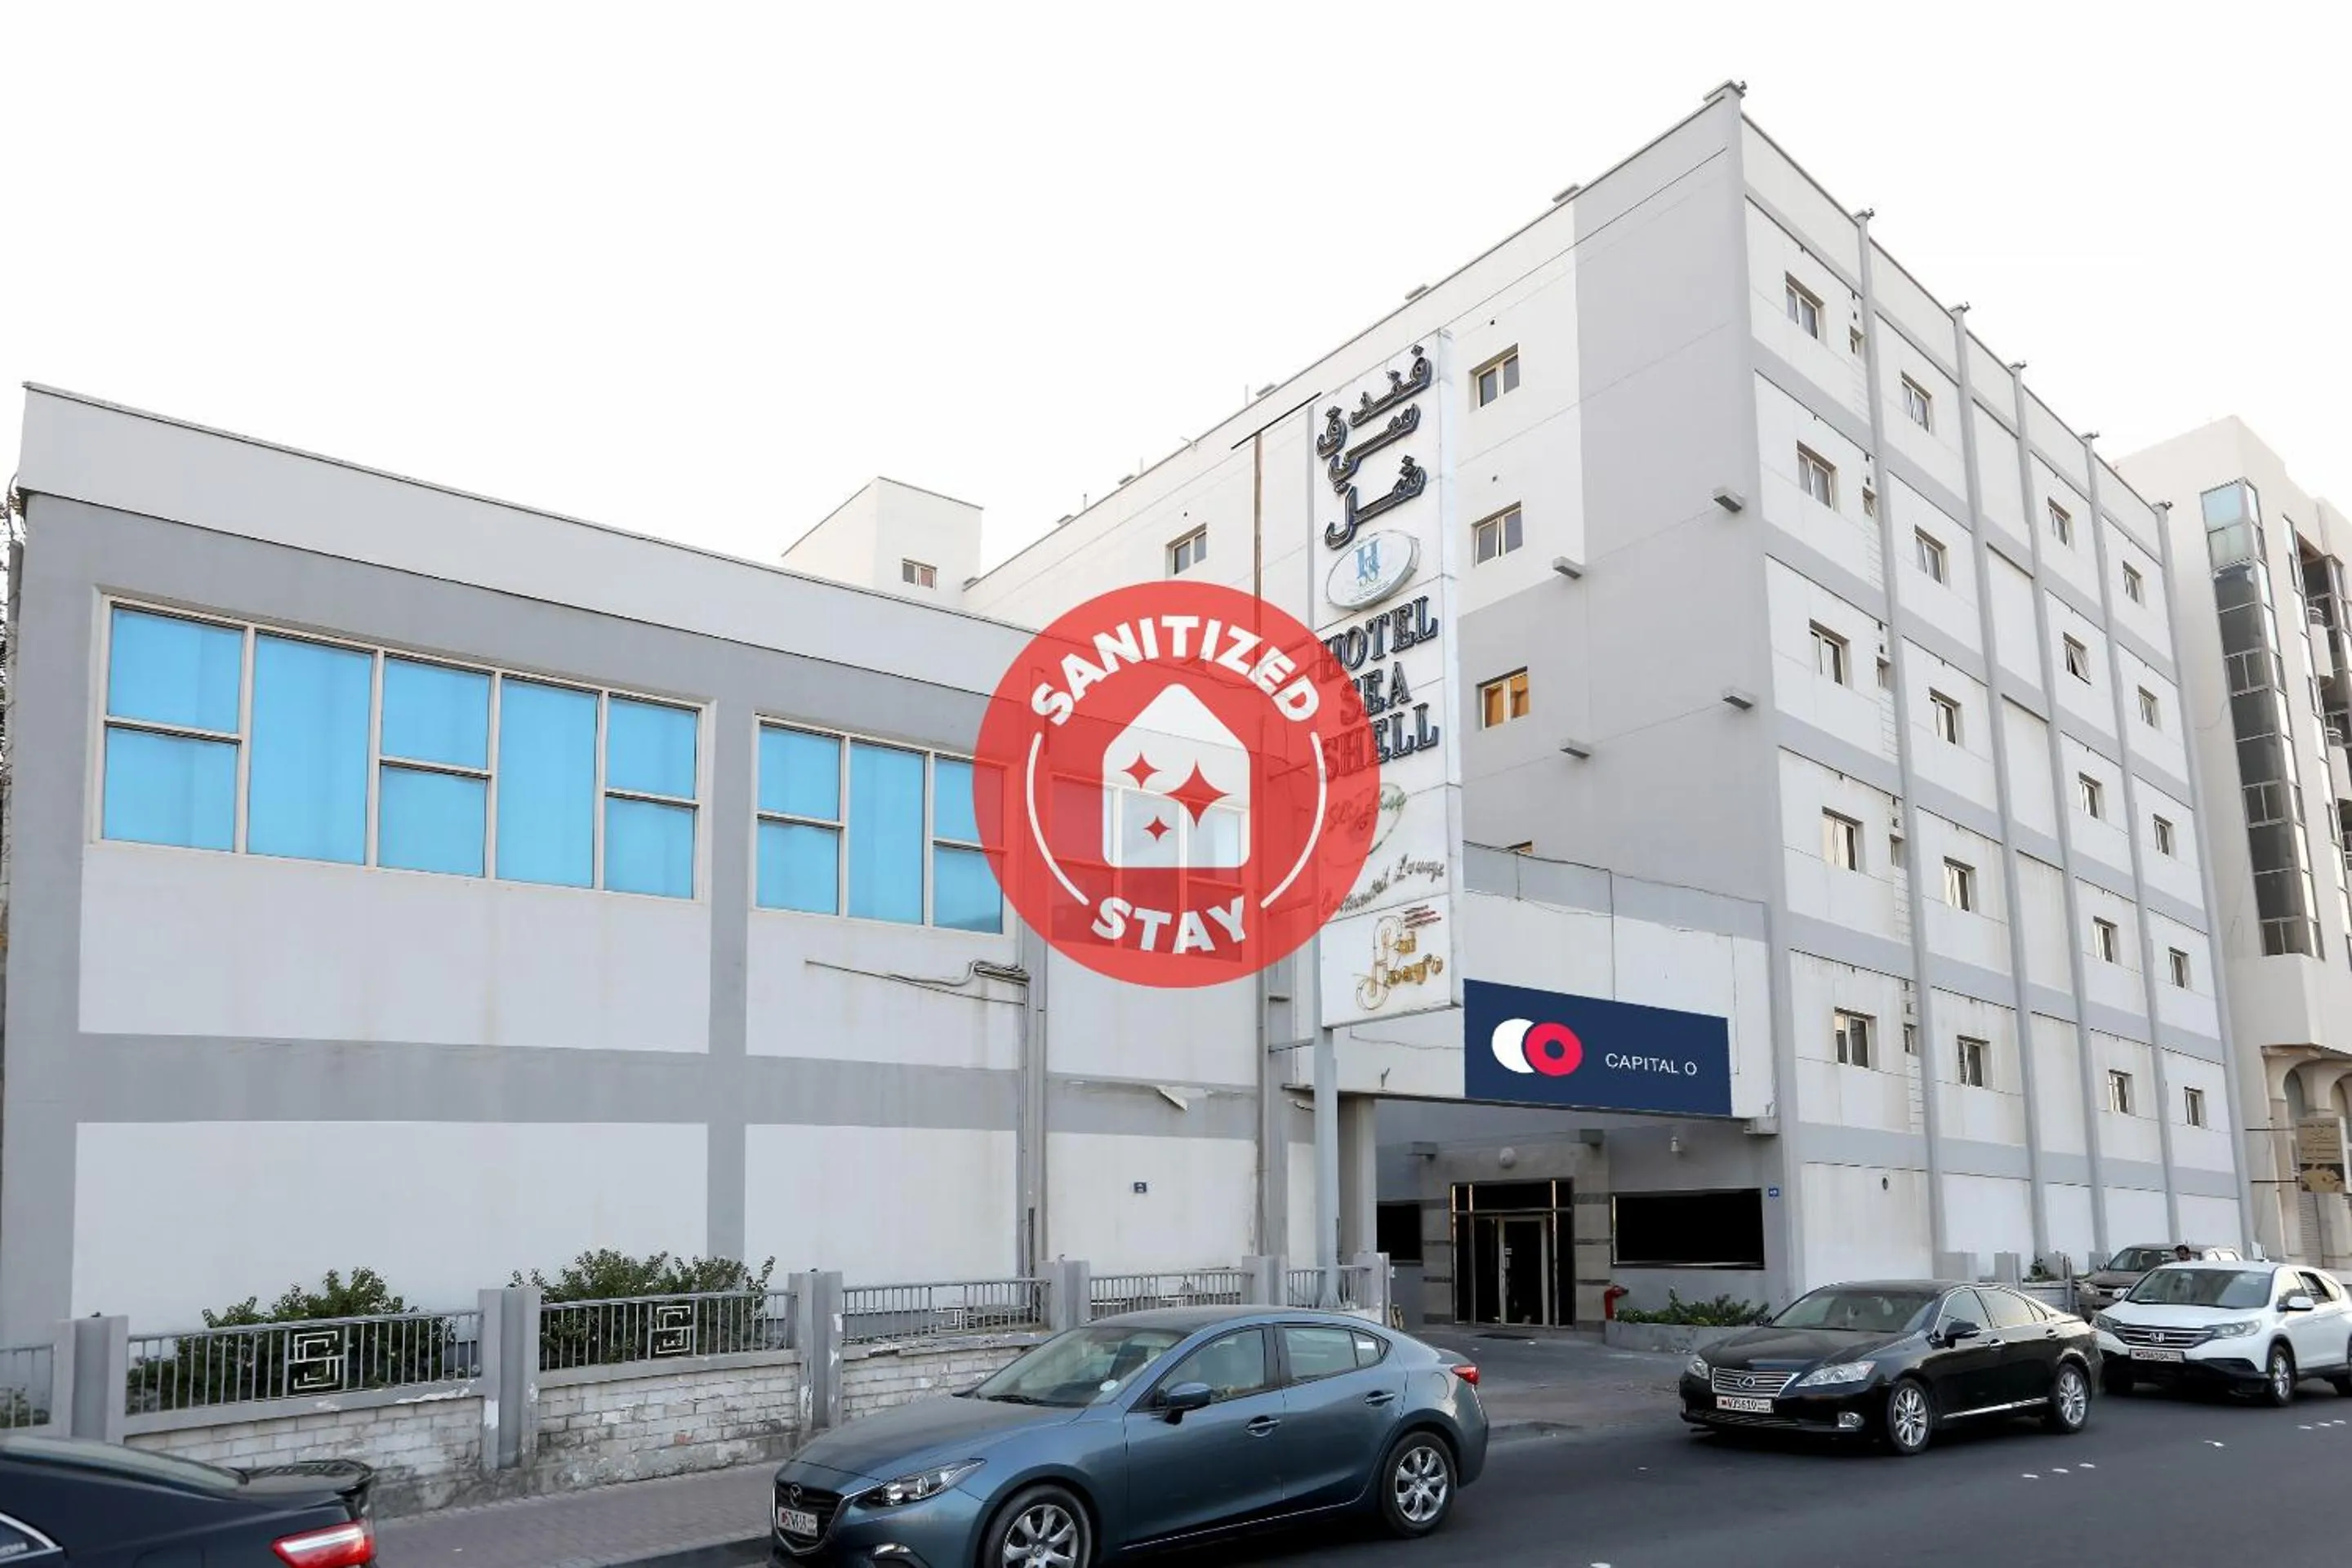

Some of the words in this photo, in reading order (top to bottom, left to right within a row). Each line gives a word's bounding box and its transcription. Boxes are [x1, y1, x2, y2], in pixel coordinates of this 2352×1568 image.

[1316, 345, 1432, 460] فندق
[1328, 403, 1421, 494] سي
[1325, 455, 1428, 550] شل
[1317, 595, 1439, 684] HOTEL
[1339, 662, 1413, 725] SEA
[1605, 1053, 1679, 1074] CAPITAL
[1684, 1062, 1698, 1076] O
